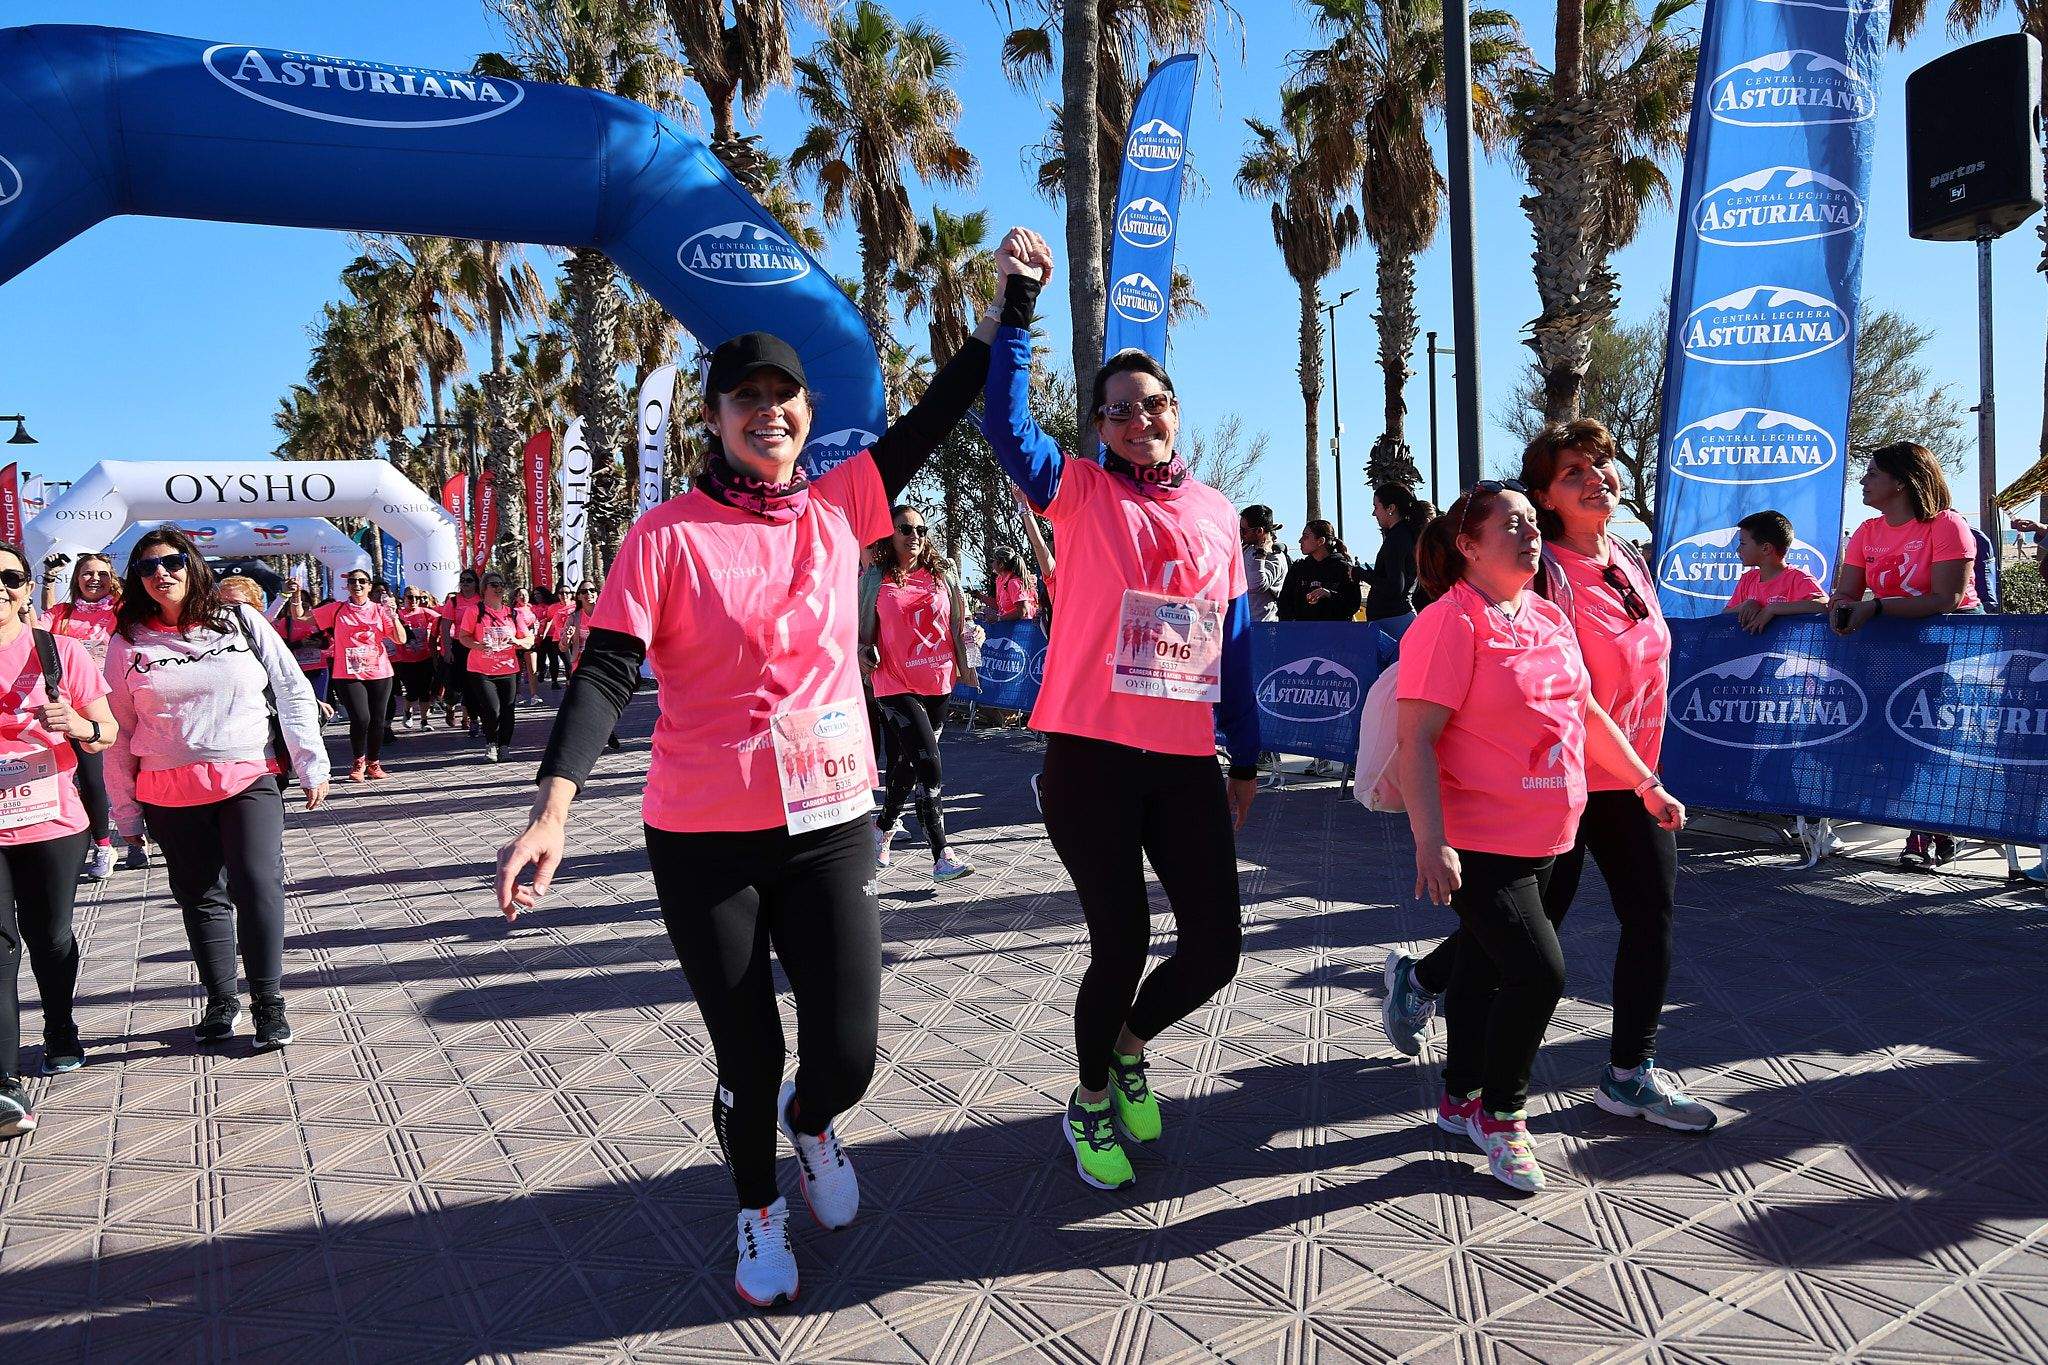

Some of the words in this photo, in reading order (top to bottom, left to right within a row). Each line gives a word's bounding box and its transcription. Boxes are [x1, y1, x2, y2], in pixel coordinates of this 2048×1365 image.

[232, 49, 505, 103] ASTURIANA
[1744, 76, 1804, 87] CENTRAL
[1714, 81, 1864, 112] ASTURIANA
[1129, 138, 1181, 160] ASTURIANA
[1727, 192, 1784, 206] CENTRAL
[1789, 191, 1848, 202] LECHERA
[1120, 214, 1167, 237] ASTURIANA
[1699, 201, 1850, 231] ASTURIANA
[689, 244, 804, 270] ASTURIANA
[711, 242, 756, 250] CENTRAL
[1115, 287, 1158, 313] ASTURIANA
[1712, 312, 1767, 324] CENTRAL
[1772, 310, 1831, 320] LECHERA
[1686, 319, 1834, 349] ASTURIANA
[1701, 434, 1756, 443] CENTRAL
[1762, 433, 1818, 443] LECHERA
[1675, 438, 1823, 467] ASTURIANA
[165, 473, 336, 504] OYSHO
[533, 454, 544, 534] Santander
[3, 487, 15, 546] ntander
[56, 510, 112, 521] OYSHO
[383, 504, 428, 514] OYSHO
[478, 485, 492, 549] Santander
[566, 445, 590, 587] OYSHO
[413, 561, 456, 572] OYSHO
[1692, 551, 1740, 560] CENTRA
[711, 566, 765, 579] OYSHO
[1156, 640, 1191, 660] 016
[980, 656, 1020, 673] STURIANA
[1126, 679, 1160, 691] OYSHO
[1177, 686, 1208, 695] Santander
[1261, 679, 1351, 709] ASTURIANA
[1713, 685, 1774, 695] CENTRAL
[1680, 688, 1849, 725] ASTURIANA
[1902, 689, 2048, 735] ASTURI
[824, 753, 856, 777] 016
[802, 808, 840, 824] OYSHO
